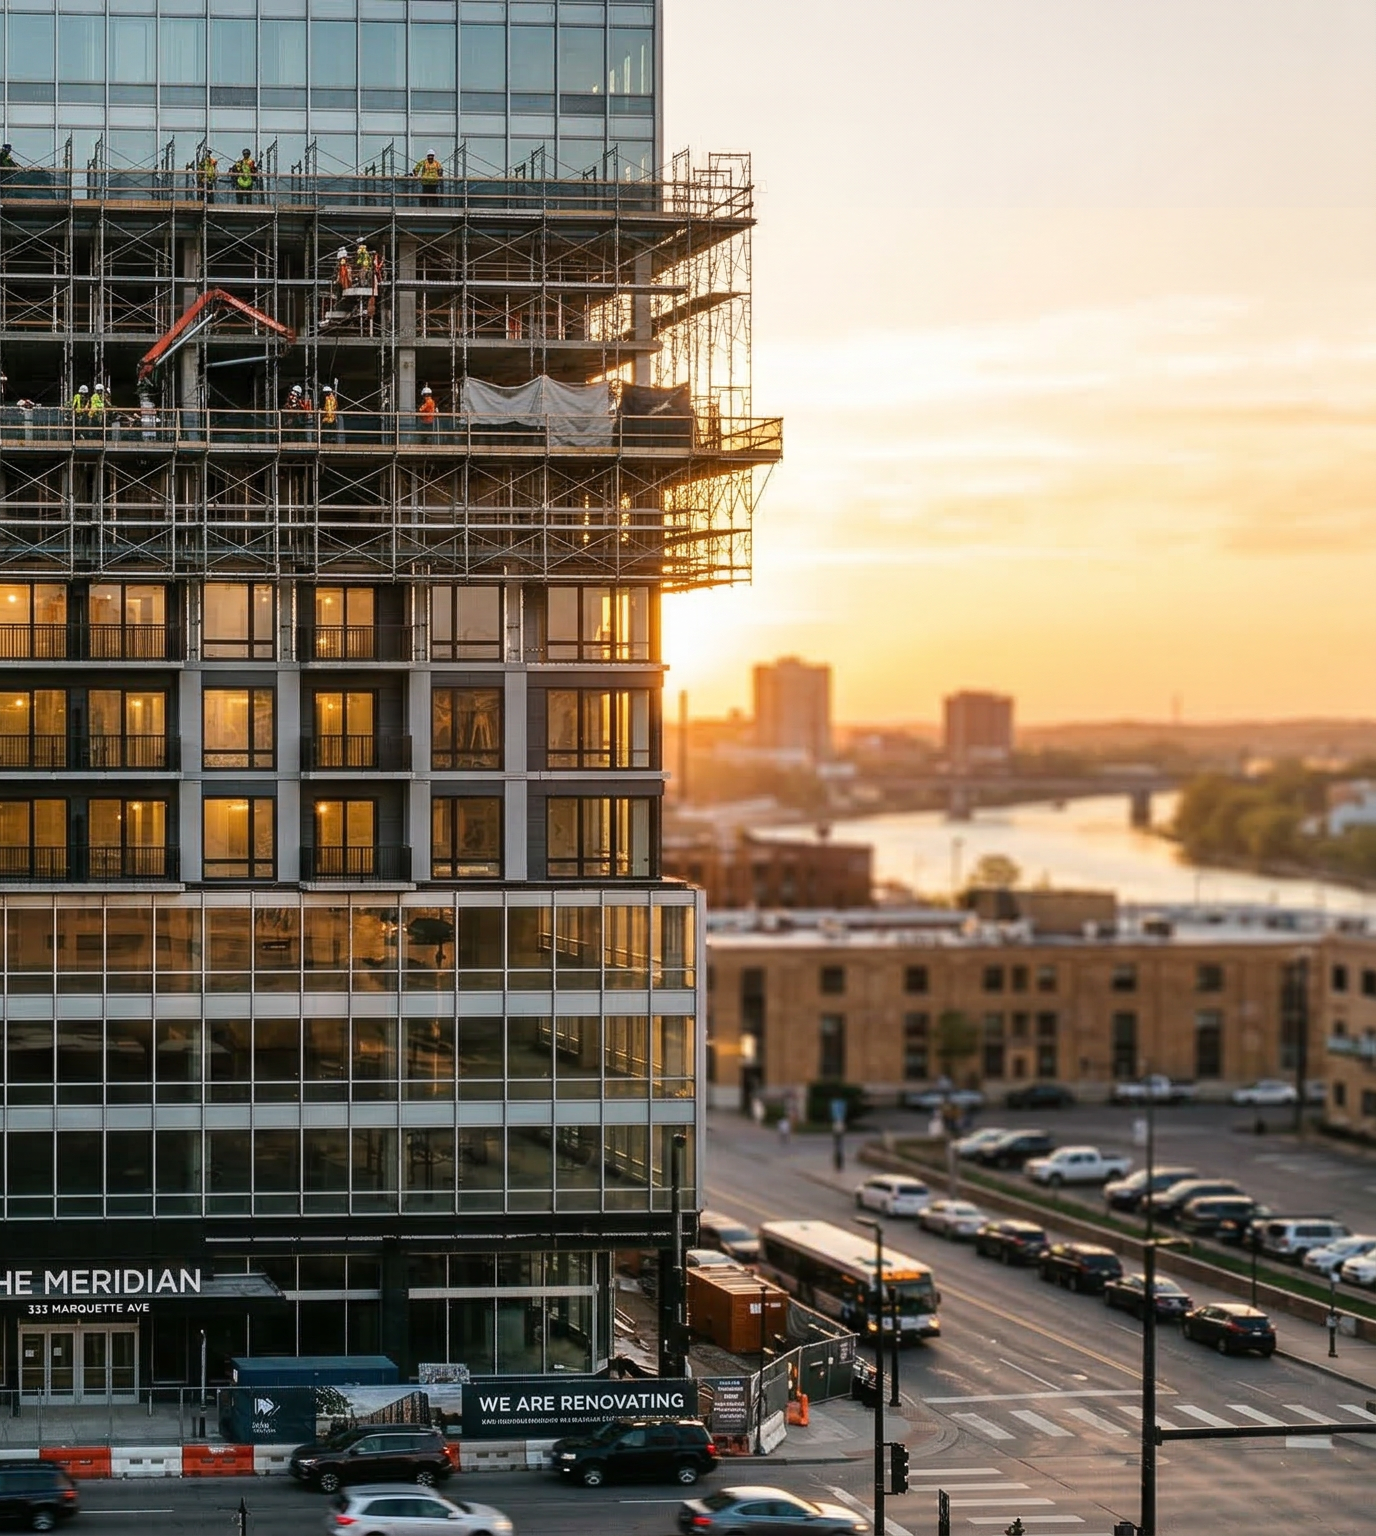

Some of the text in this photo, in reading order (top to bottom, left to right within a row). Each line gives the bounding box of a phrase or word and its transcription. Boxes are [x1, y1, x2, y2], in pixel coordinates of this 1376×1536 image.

[44, 1268, 201, 1295] MERIDIAN
[28, 1302, 150, 1315] 333 MARQUETTE AVE
[478, 1392, 684, 1413] WE ARE RENOVATING
